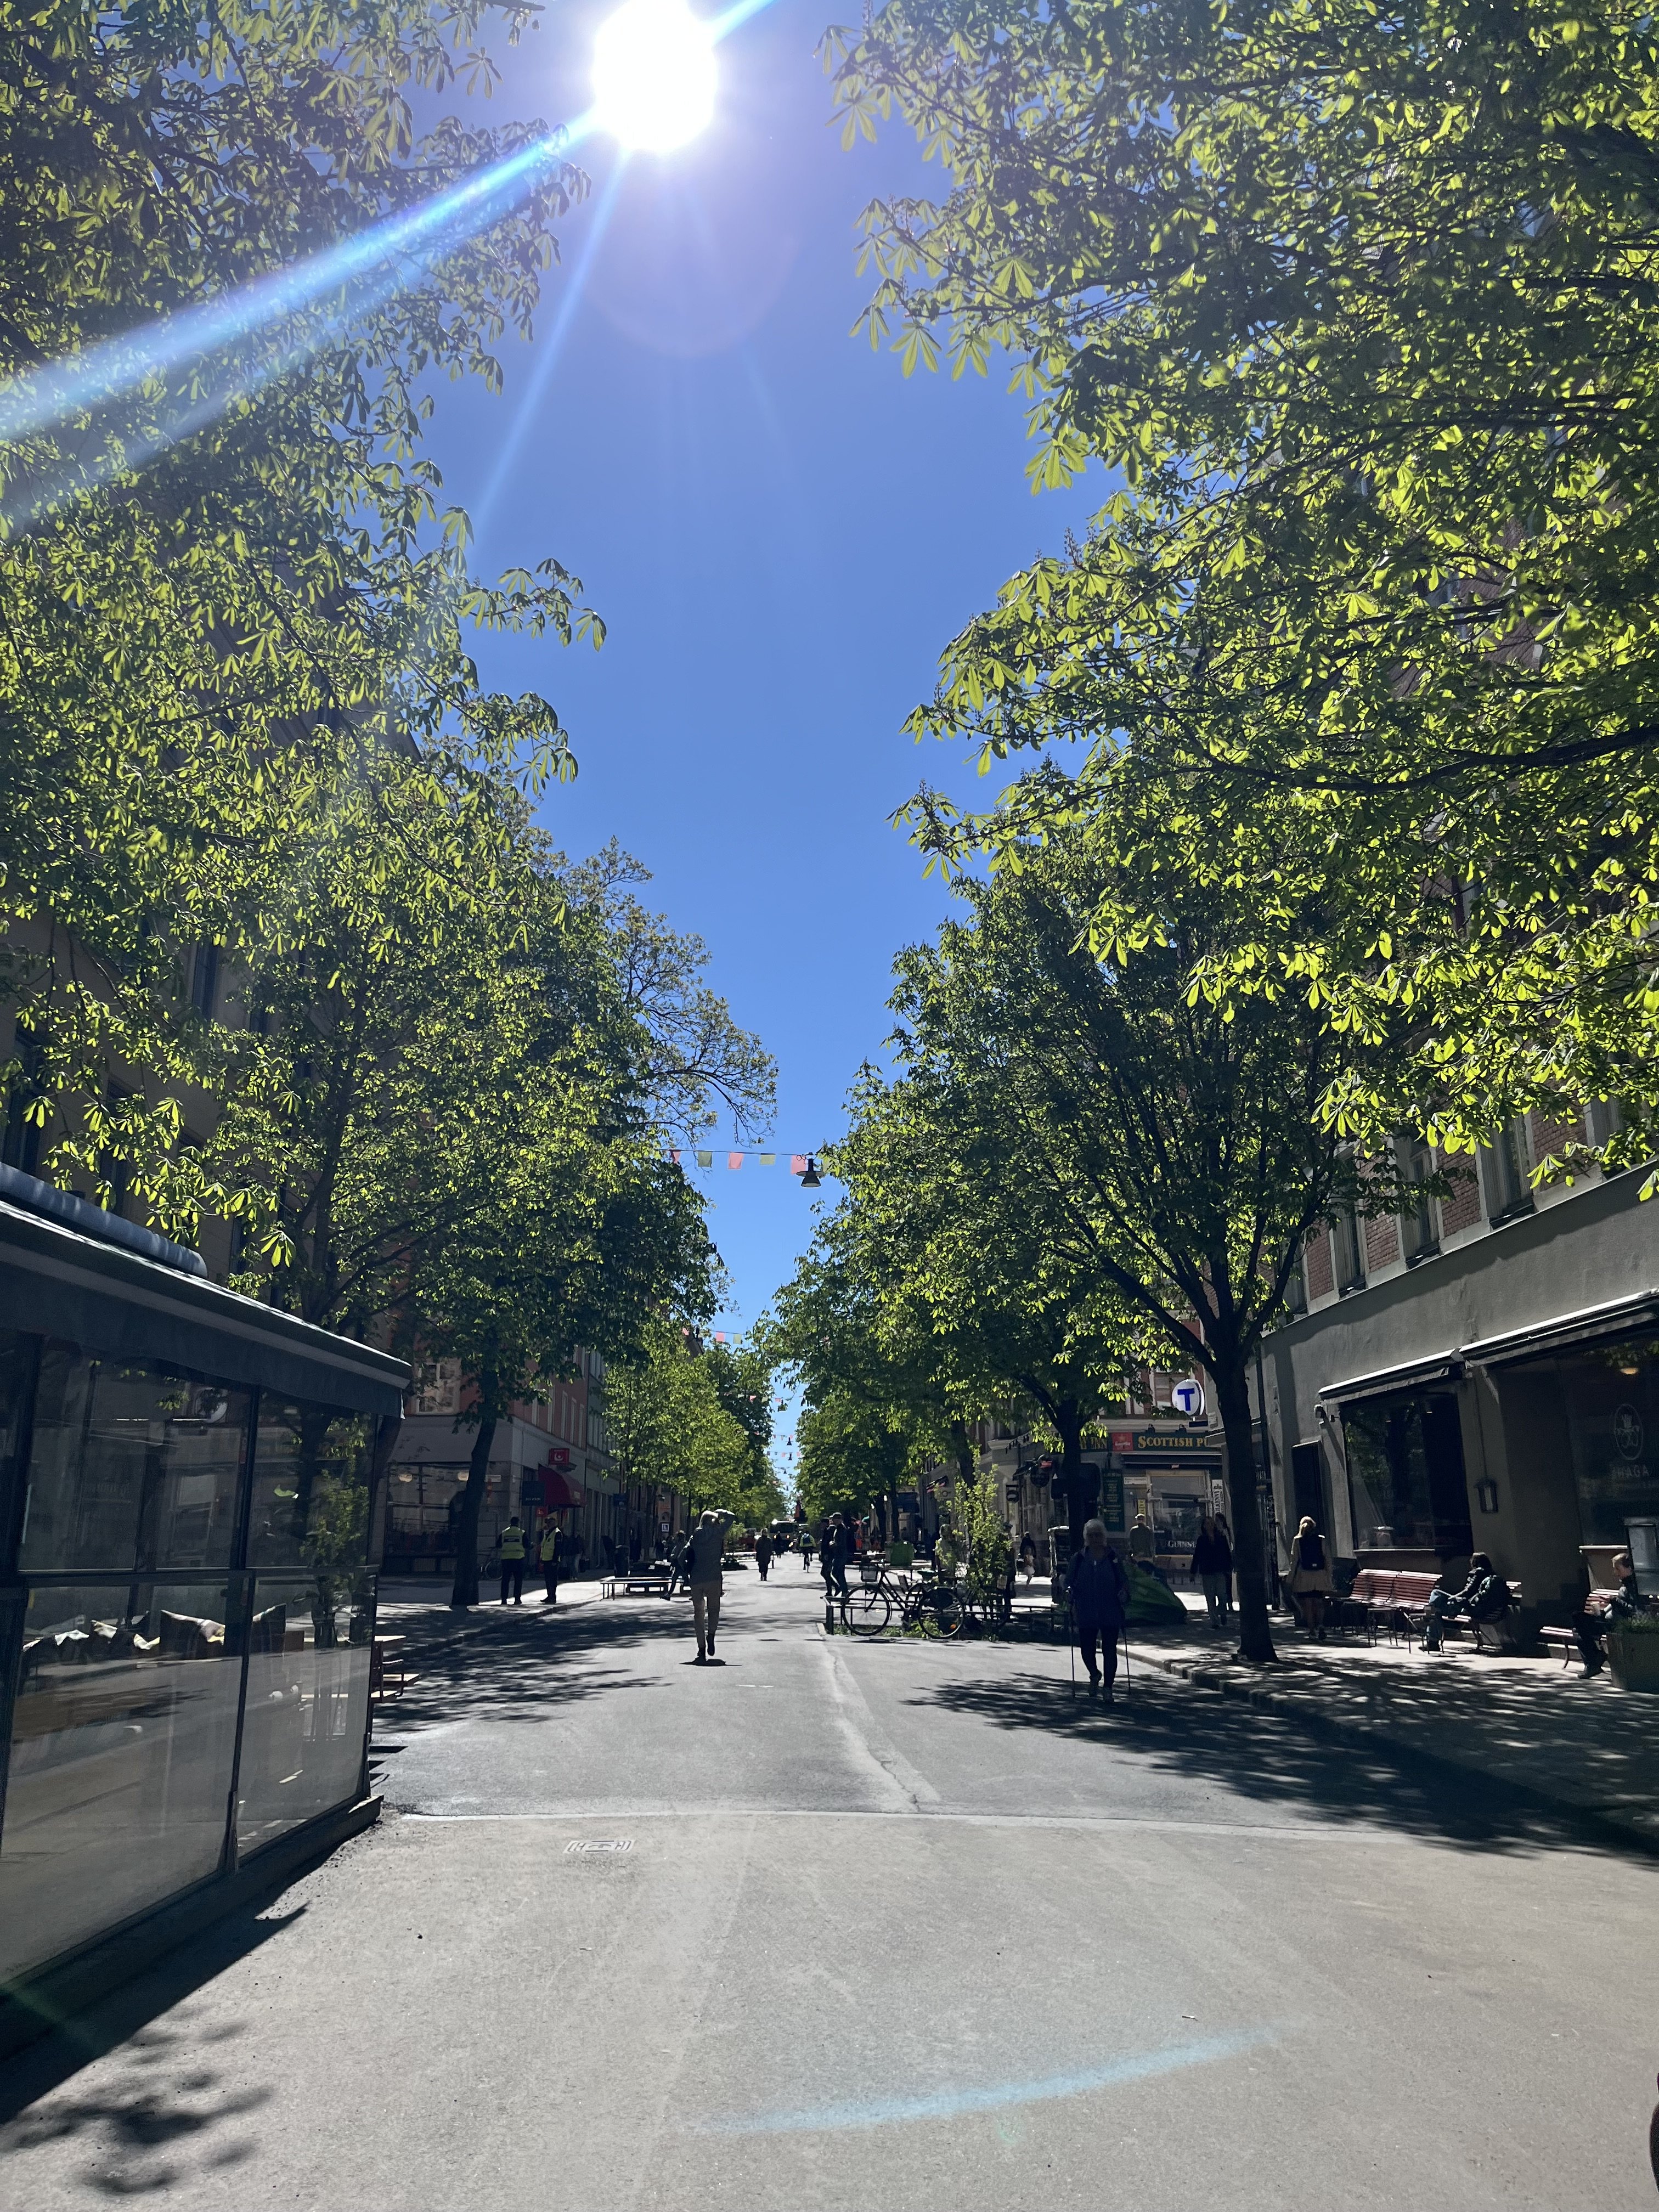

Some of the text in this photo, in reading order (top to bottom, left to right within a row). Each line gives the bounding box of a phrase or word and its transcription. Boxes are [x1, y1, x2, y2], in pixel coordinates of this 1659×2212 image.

[1177, 1388, 1195, 1410] T
[1138, 1436, 1193, 1448] SCOTTISH
[1196, 1437, 1208, 1447] PU
